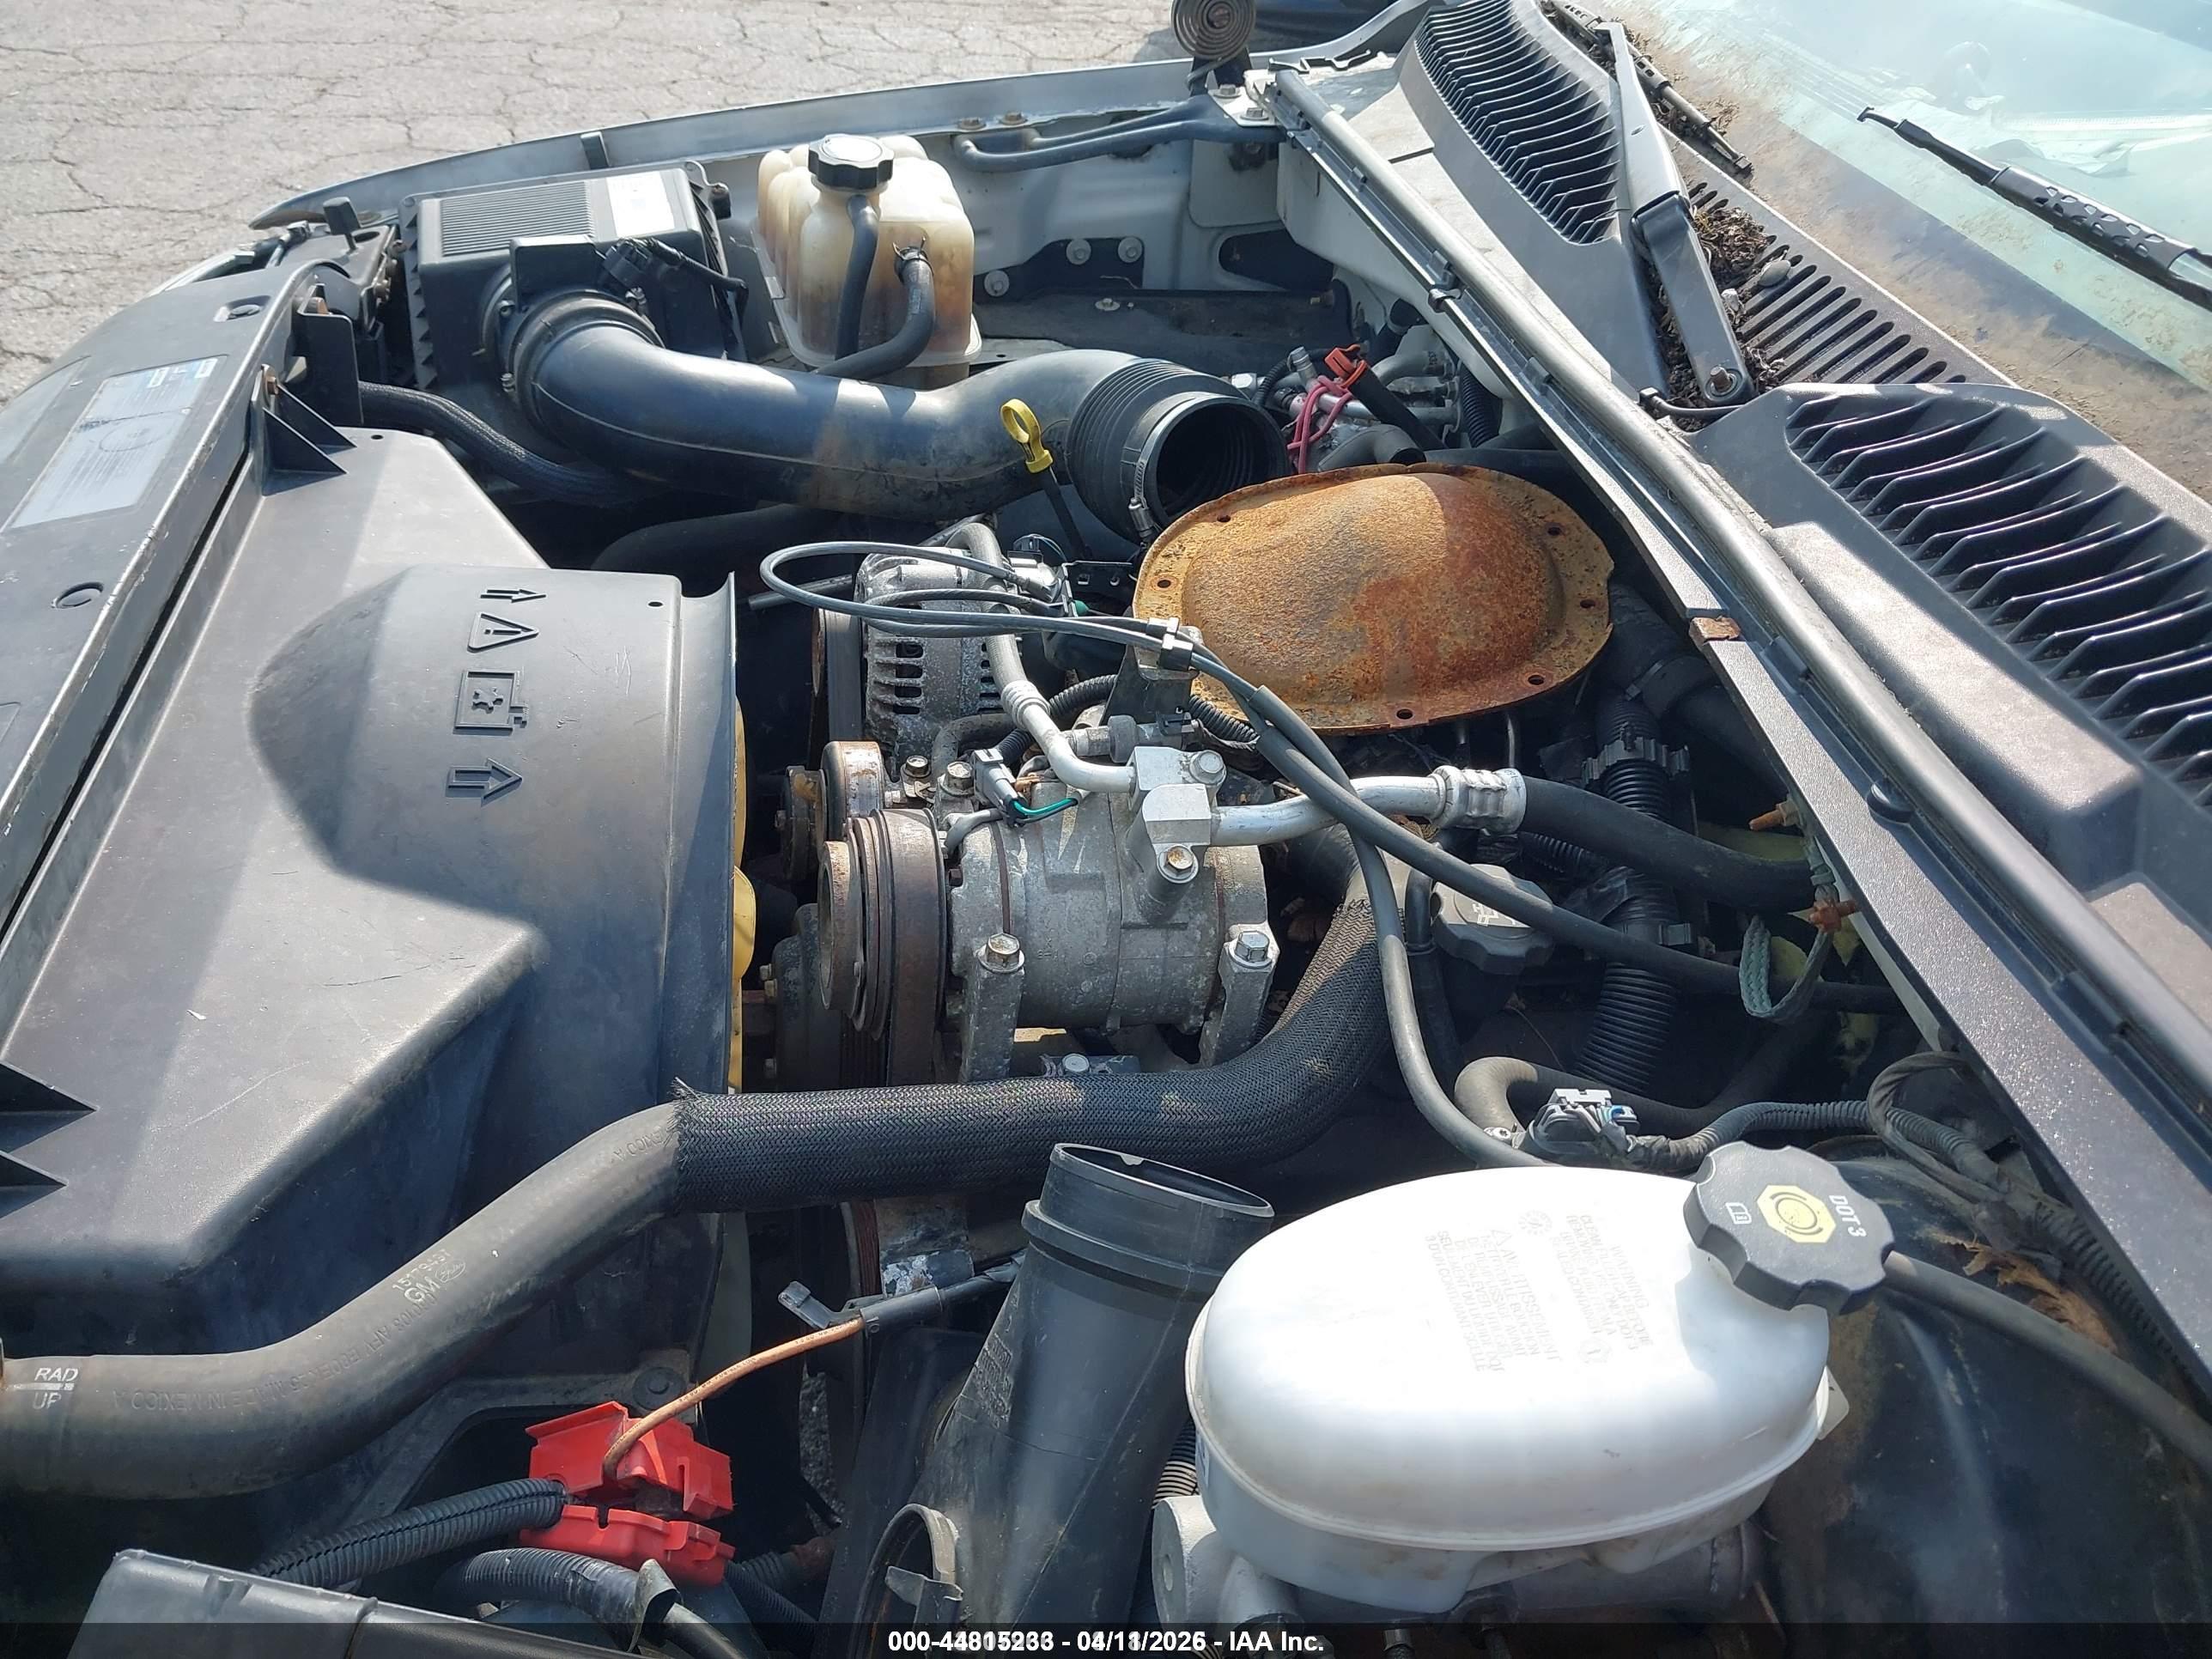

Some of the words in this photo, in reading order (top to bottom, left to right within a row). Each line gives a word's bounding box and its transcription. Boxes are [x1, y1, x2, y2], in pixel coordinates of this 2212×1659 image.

[1829, 1194, 1863, 1225] DOT
[1848, 1226, 1867, 1237] 3
[404, 1275, 441, 1306] GM
[1616, 1319, 1633, 1339] DOT
[33, 1366, 79, 1382] RAD
[33, 1392, 63, 1410] UP
